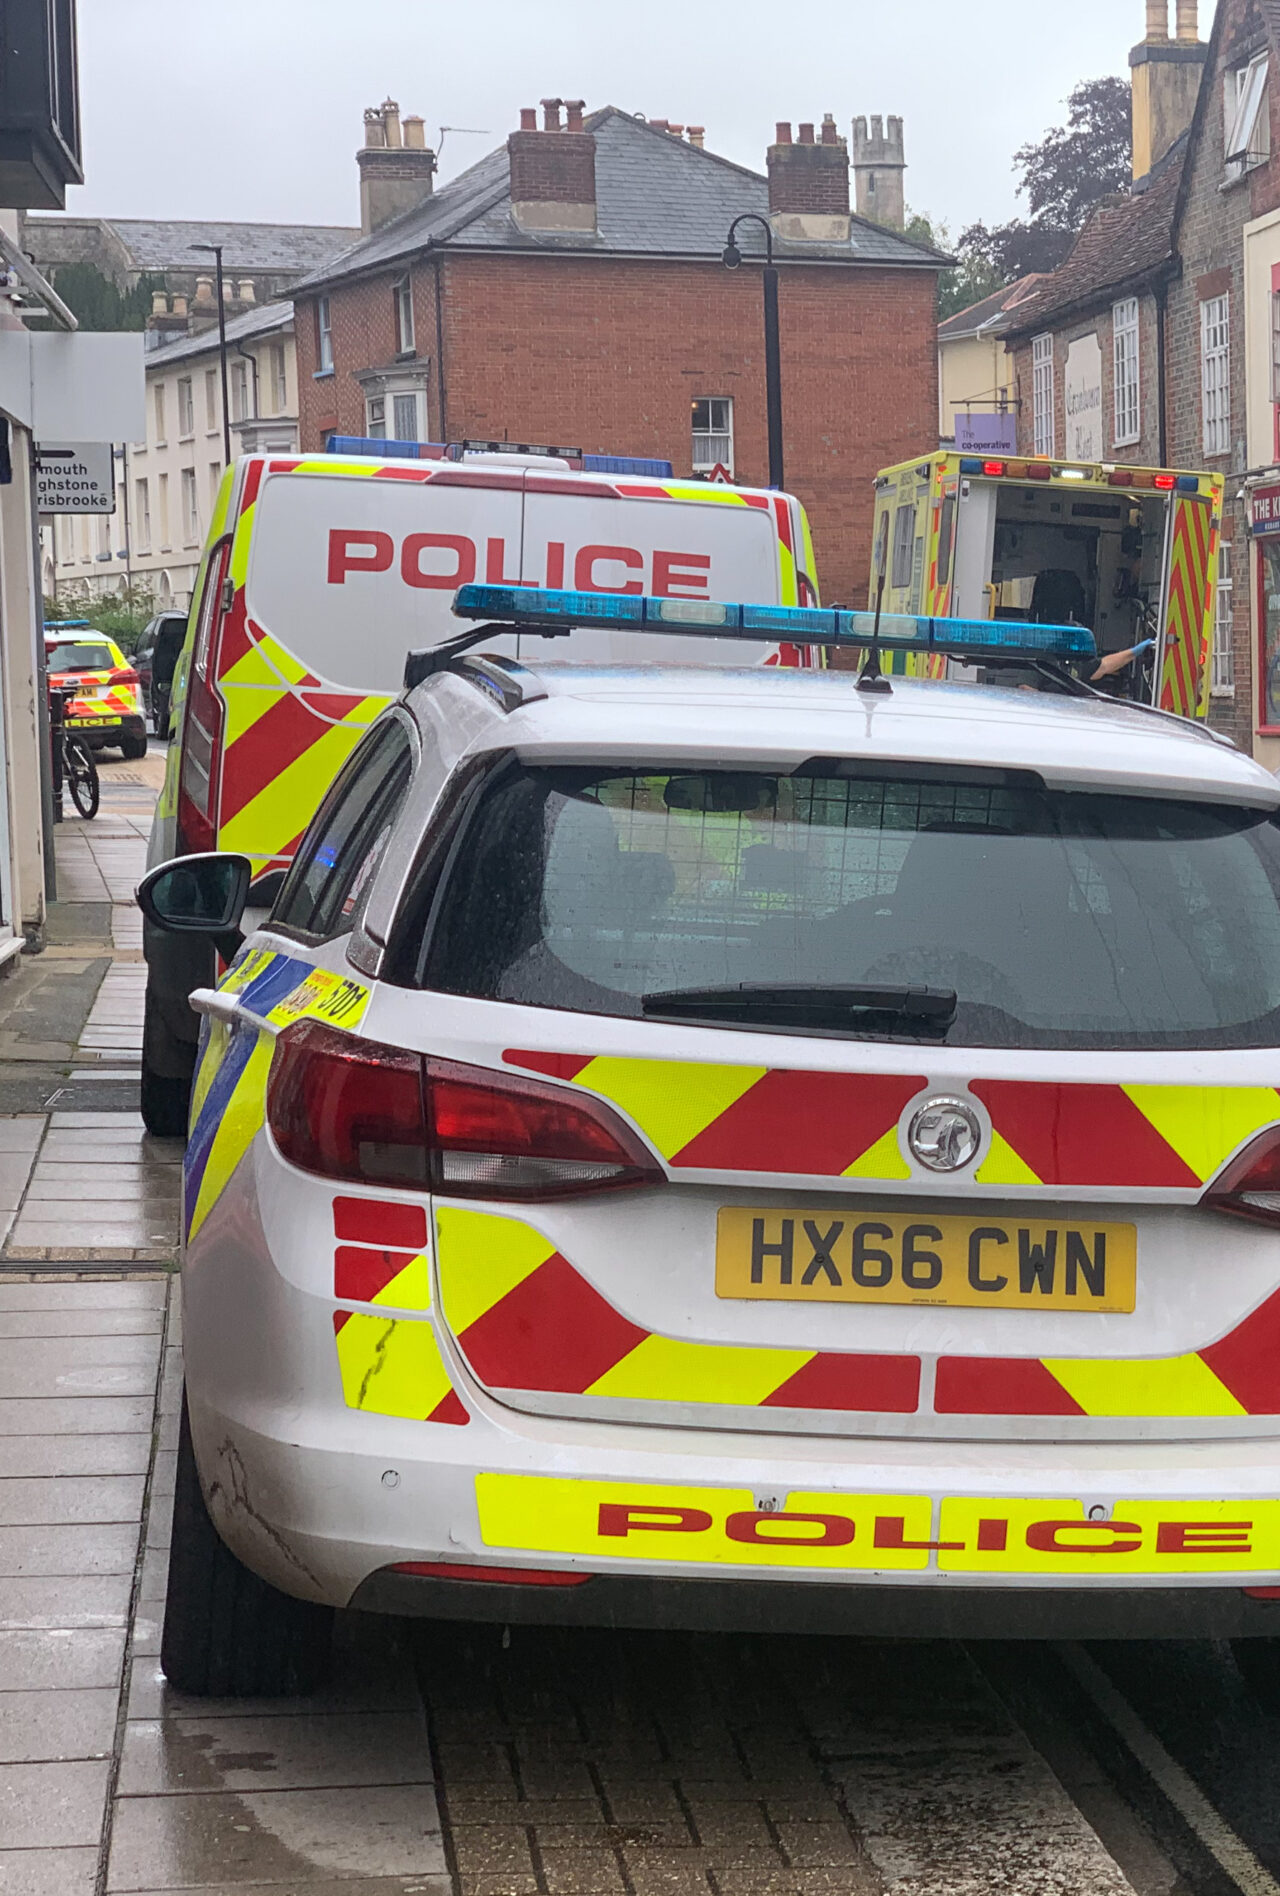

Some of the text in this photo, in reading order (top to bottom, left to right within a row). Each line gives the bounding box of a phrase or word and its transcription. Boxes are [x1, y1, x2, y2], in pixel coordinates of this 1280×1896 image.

[962, 430, 974, 439] The
[961, 441, 1011, 451] co-operative
[40, 463, 87, 475] mouth
[38, 478, 98, 492] ghstone
[37, 494, 107, 506] risbrooke
[1253, 498, 1270, 520] THE
[327, 529, 711, 601] POLICE
[67, 717, 116, 727] LICE
[750, 1217, 1107, 1297] HX66 CWN
[598, 1502, 1254, 1554] POLICE
